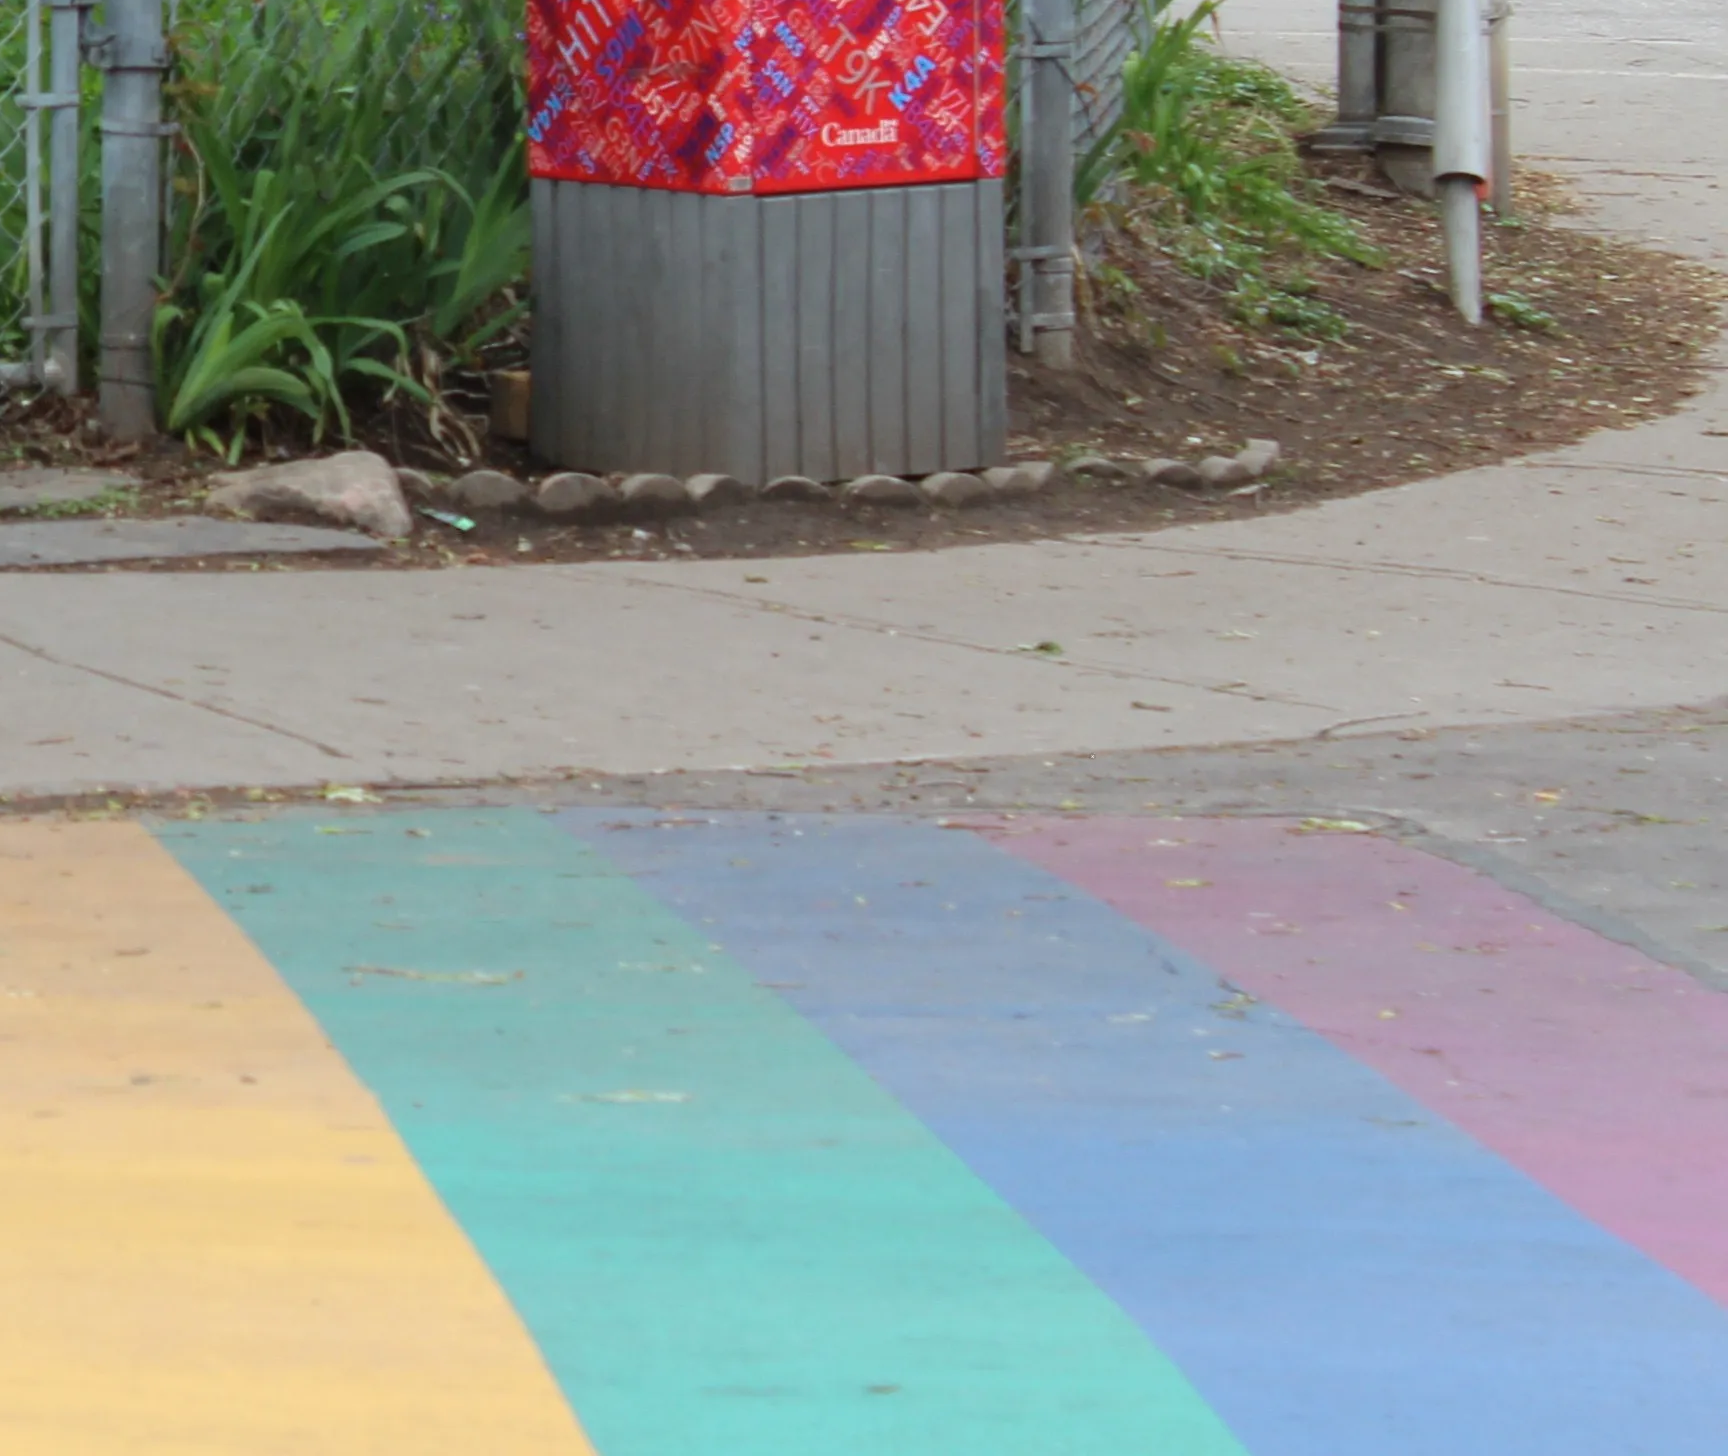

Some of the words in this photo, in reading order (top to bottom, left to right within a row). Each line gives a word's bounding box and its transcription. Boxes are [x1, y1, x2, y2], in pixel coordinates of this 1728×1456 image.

[824, 21, 893, 116] T9K
[887, 55, 936, 112] K4A
[820, 118, 899, 148] Canada
